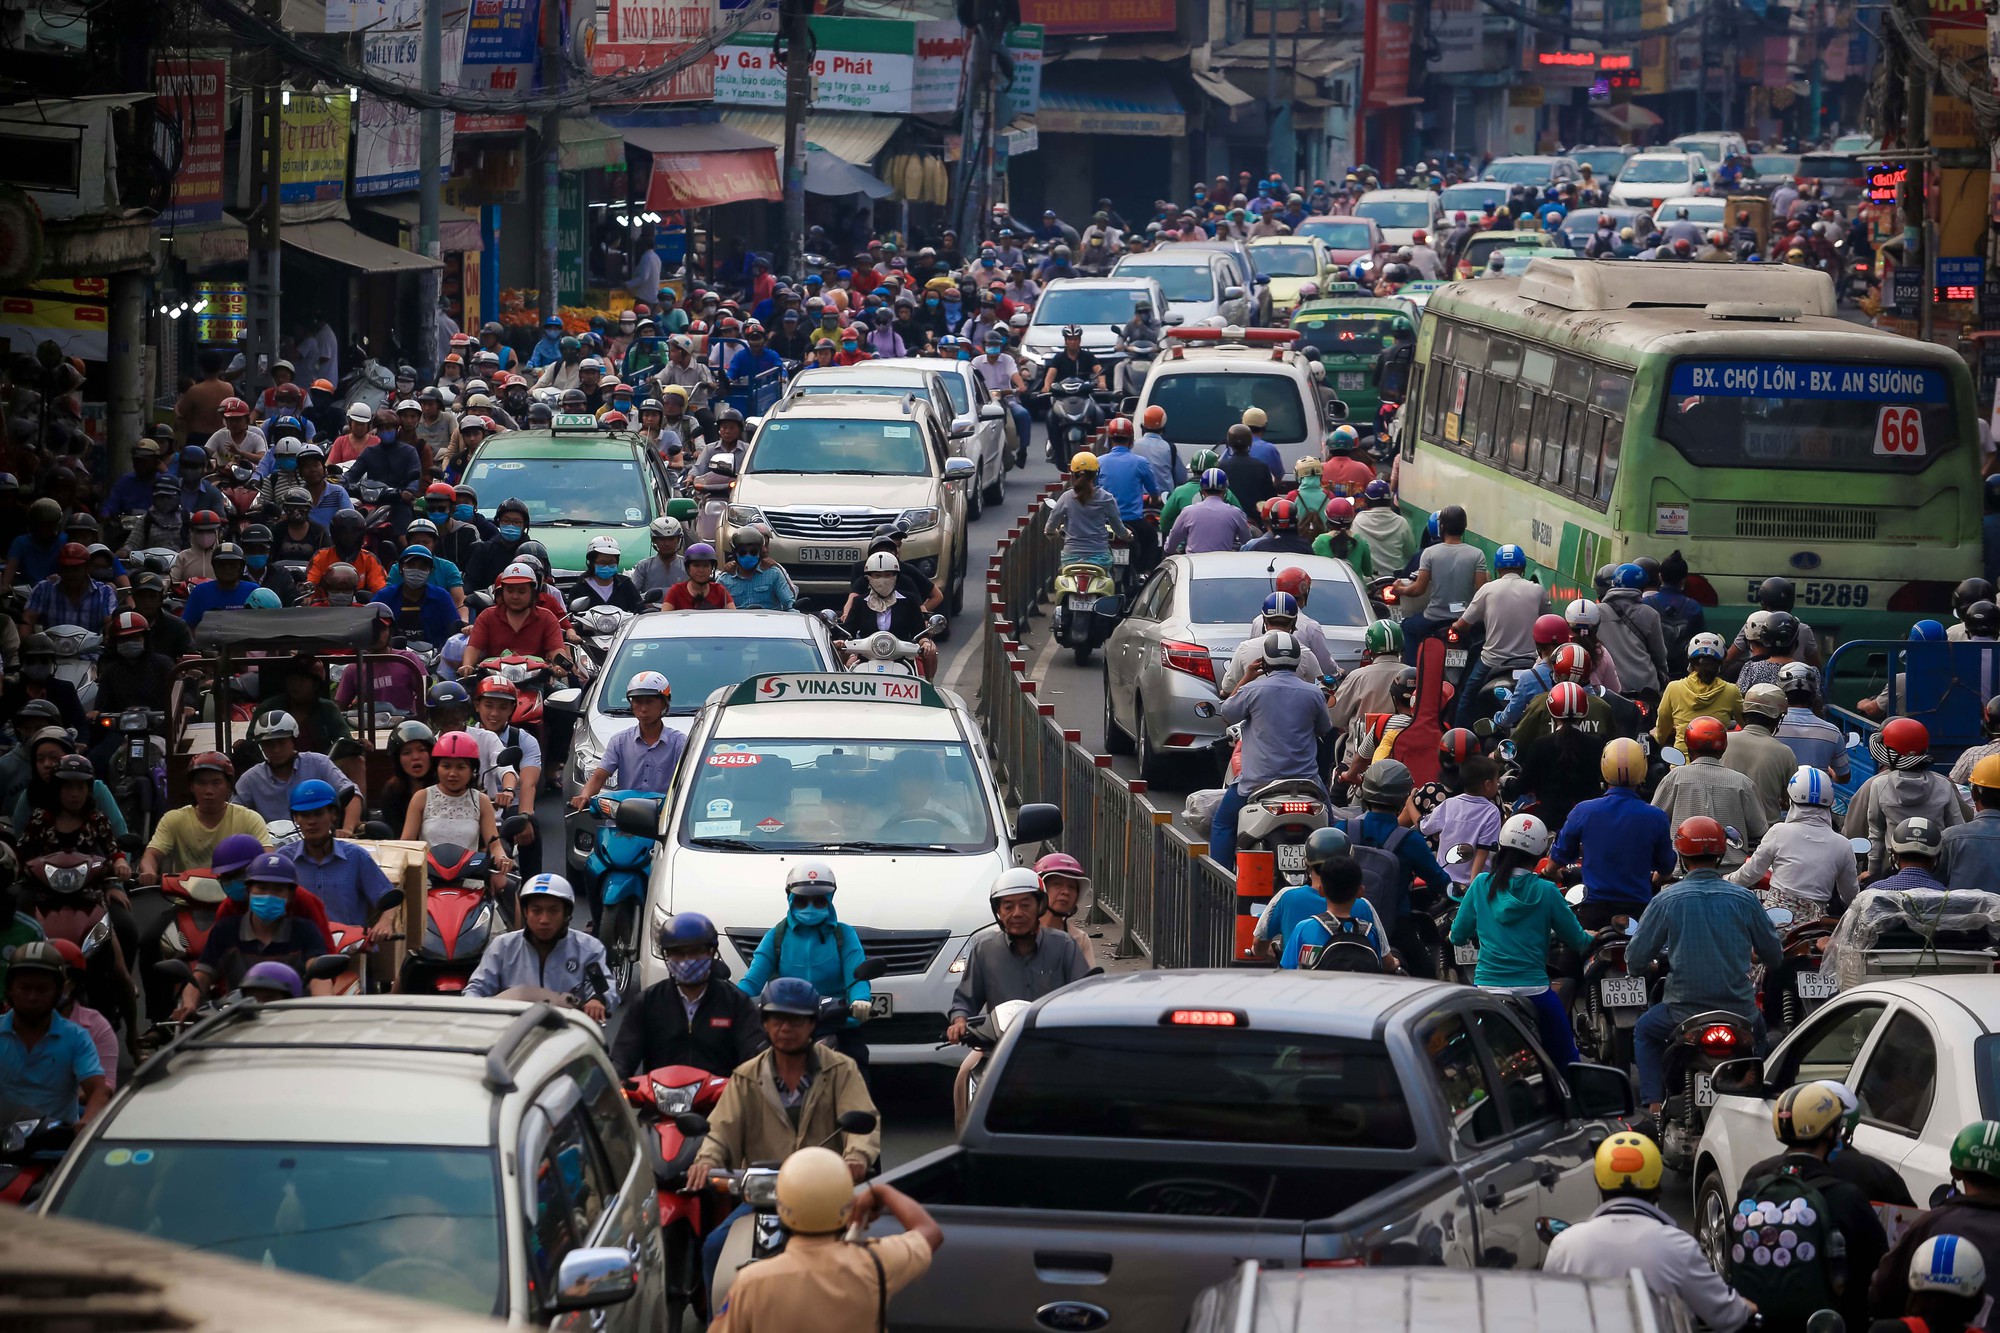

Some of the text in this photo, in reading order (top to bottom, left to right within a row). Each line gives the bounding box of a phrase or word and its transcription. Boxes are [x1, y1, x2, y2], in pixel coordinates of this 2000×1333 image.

[738, 52, 762, 69] Ga
[834, 56, 872, 75] Phát
[200, 75, 217, 95] LED
[732, 86, 766, 98] Yamaha
[837, 94, 870, 105] Piaggio
[1896, 286, 1919, 298] 592
[1692, 368, 1719, 388] BX.
[1724, 366, 1758, 395] CHỢ
[1764, 364, 1796, 390] LỚN
[1810, 371, 1836, 392] BX.
[1842, 372, 1864, 392] AN
[1868, 369, 1924, 395] SƯƠNG
[1882, 408, 1919, 452] 66
[1747, 580, 1868, 608] 5-5289
[796, 680, 919, 699] VINASUN TAXI
[710, 755, 758, 765] 8245.A
[1608, 980, 1639, 992] 59-S2
[1802, 986, 1838, 996] 137.7
[1605, 992, 1644, 1004] 069.05
